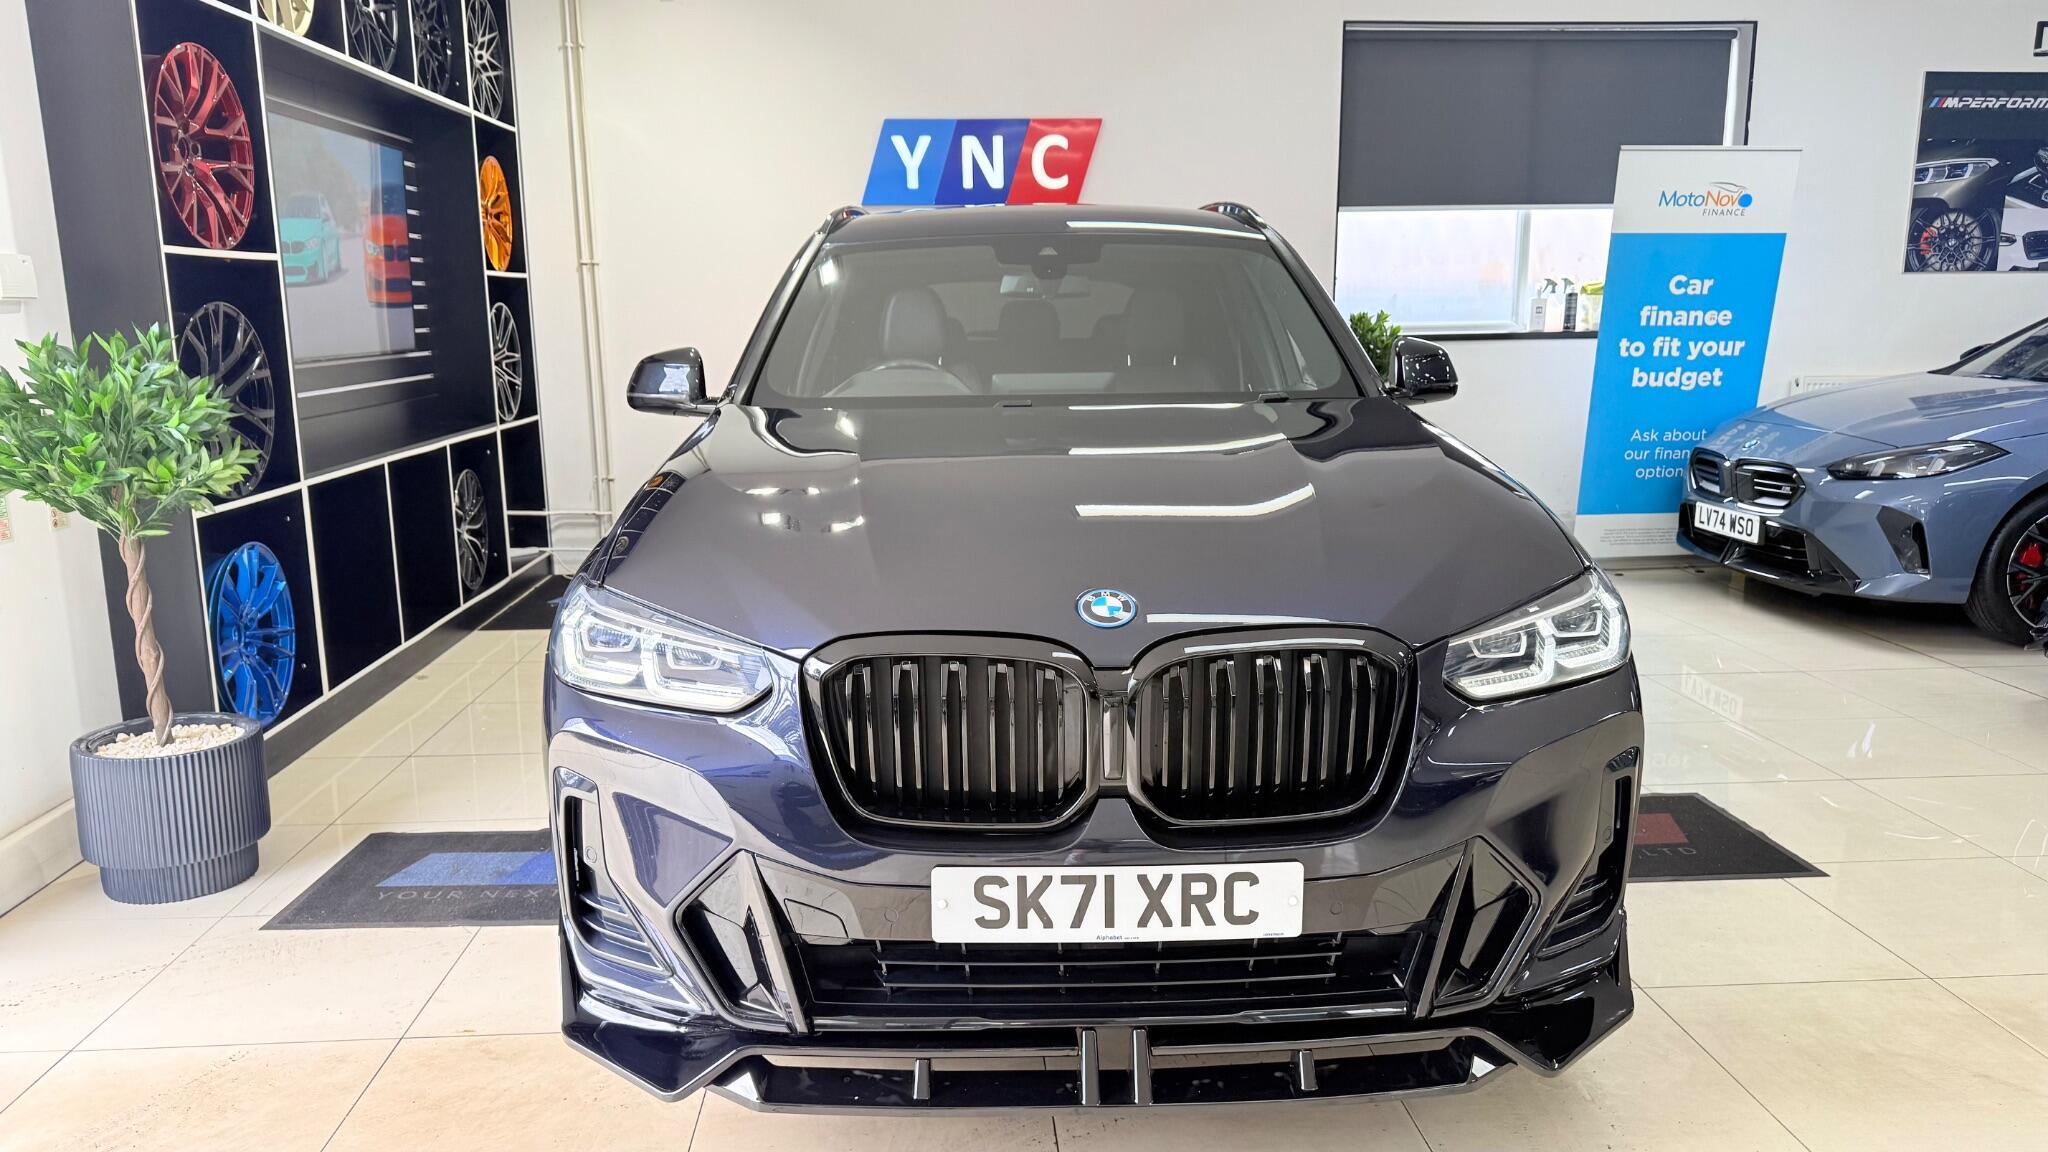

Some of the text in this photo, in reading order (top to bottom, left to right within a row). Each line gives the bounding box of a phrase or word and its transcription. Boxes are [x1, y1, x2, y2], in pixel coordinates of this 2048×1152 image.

[890, 134, 1069, 190] YNC
[1702, 208, 1746, 216] FINANCE
[1669, 274, 1714, 295] Car
[1640, 305, 1732, 326] finance
[1619, 336, 1745, 360] to fit your
[1632, 367, 1723, 391] budget
[1630, 429, 1707, 442] Ask about
[1624, 447, 1690, 460] our finan
[1635, 467, 1685, 480] option
[1698, 506, 1754, 537] LV74 WSO
[377, 890, 465, 900] YOUR
[973, 871, 1261, 930] SK71 XRC
